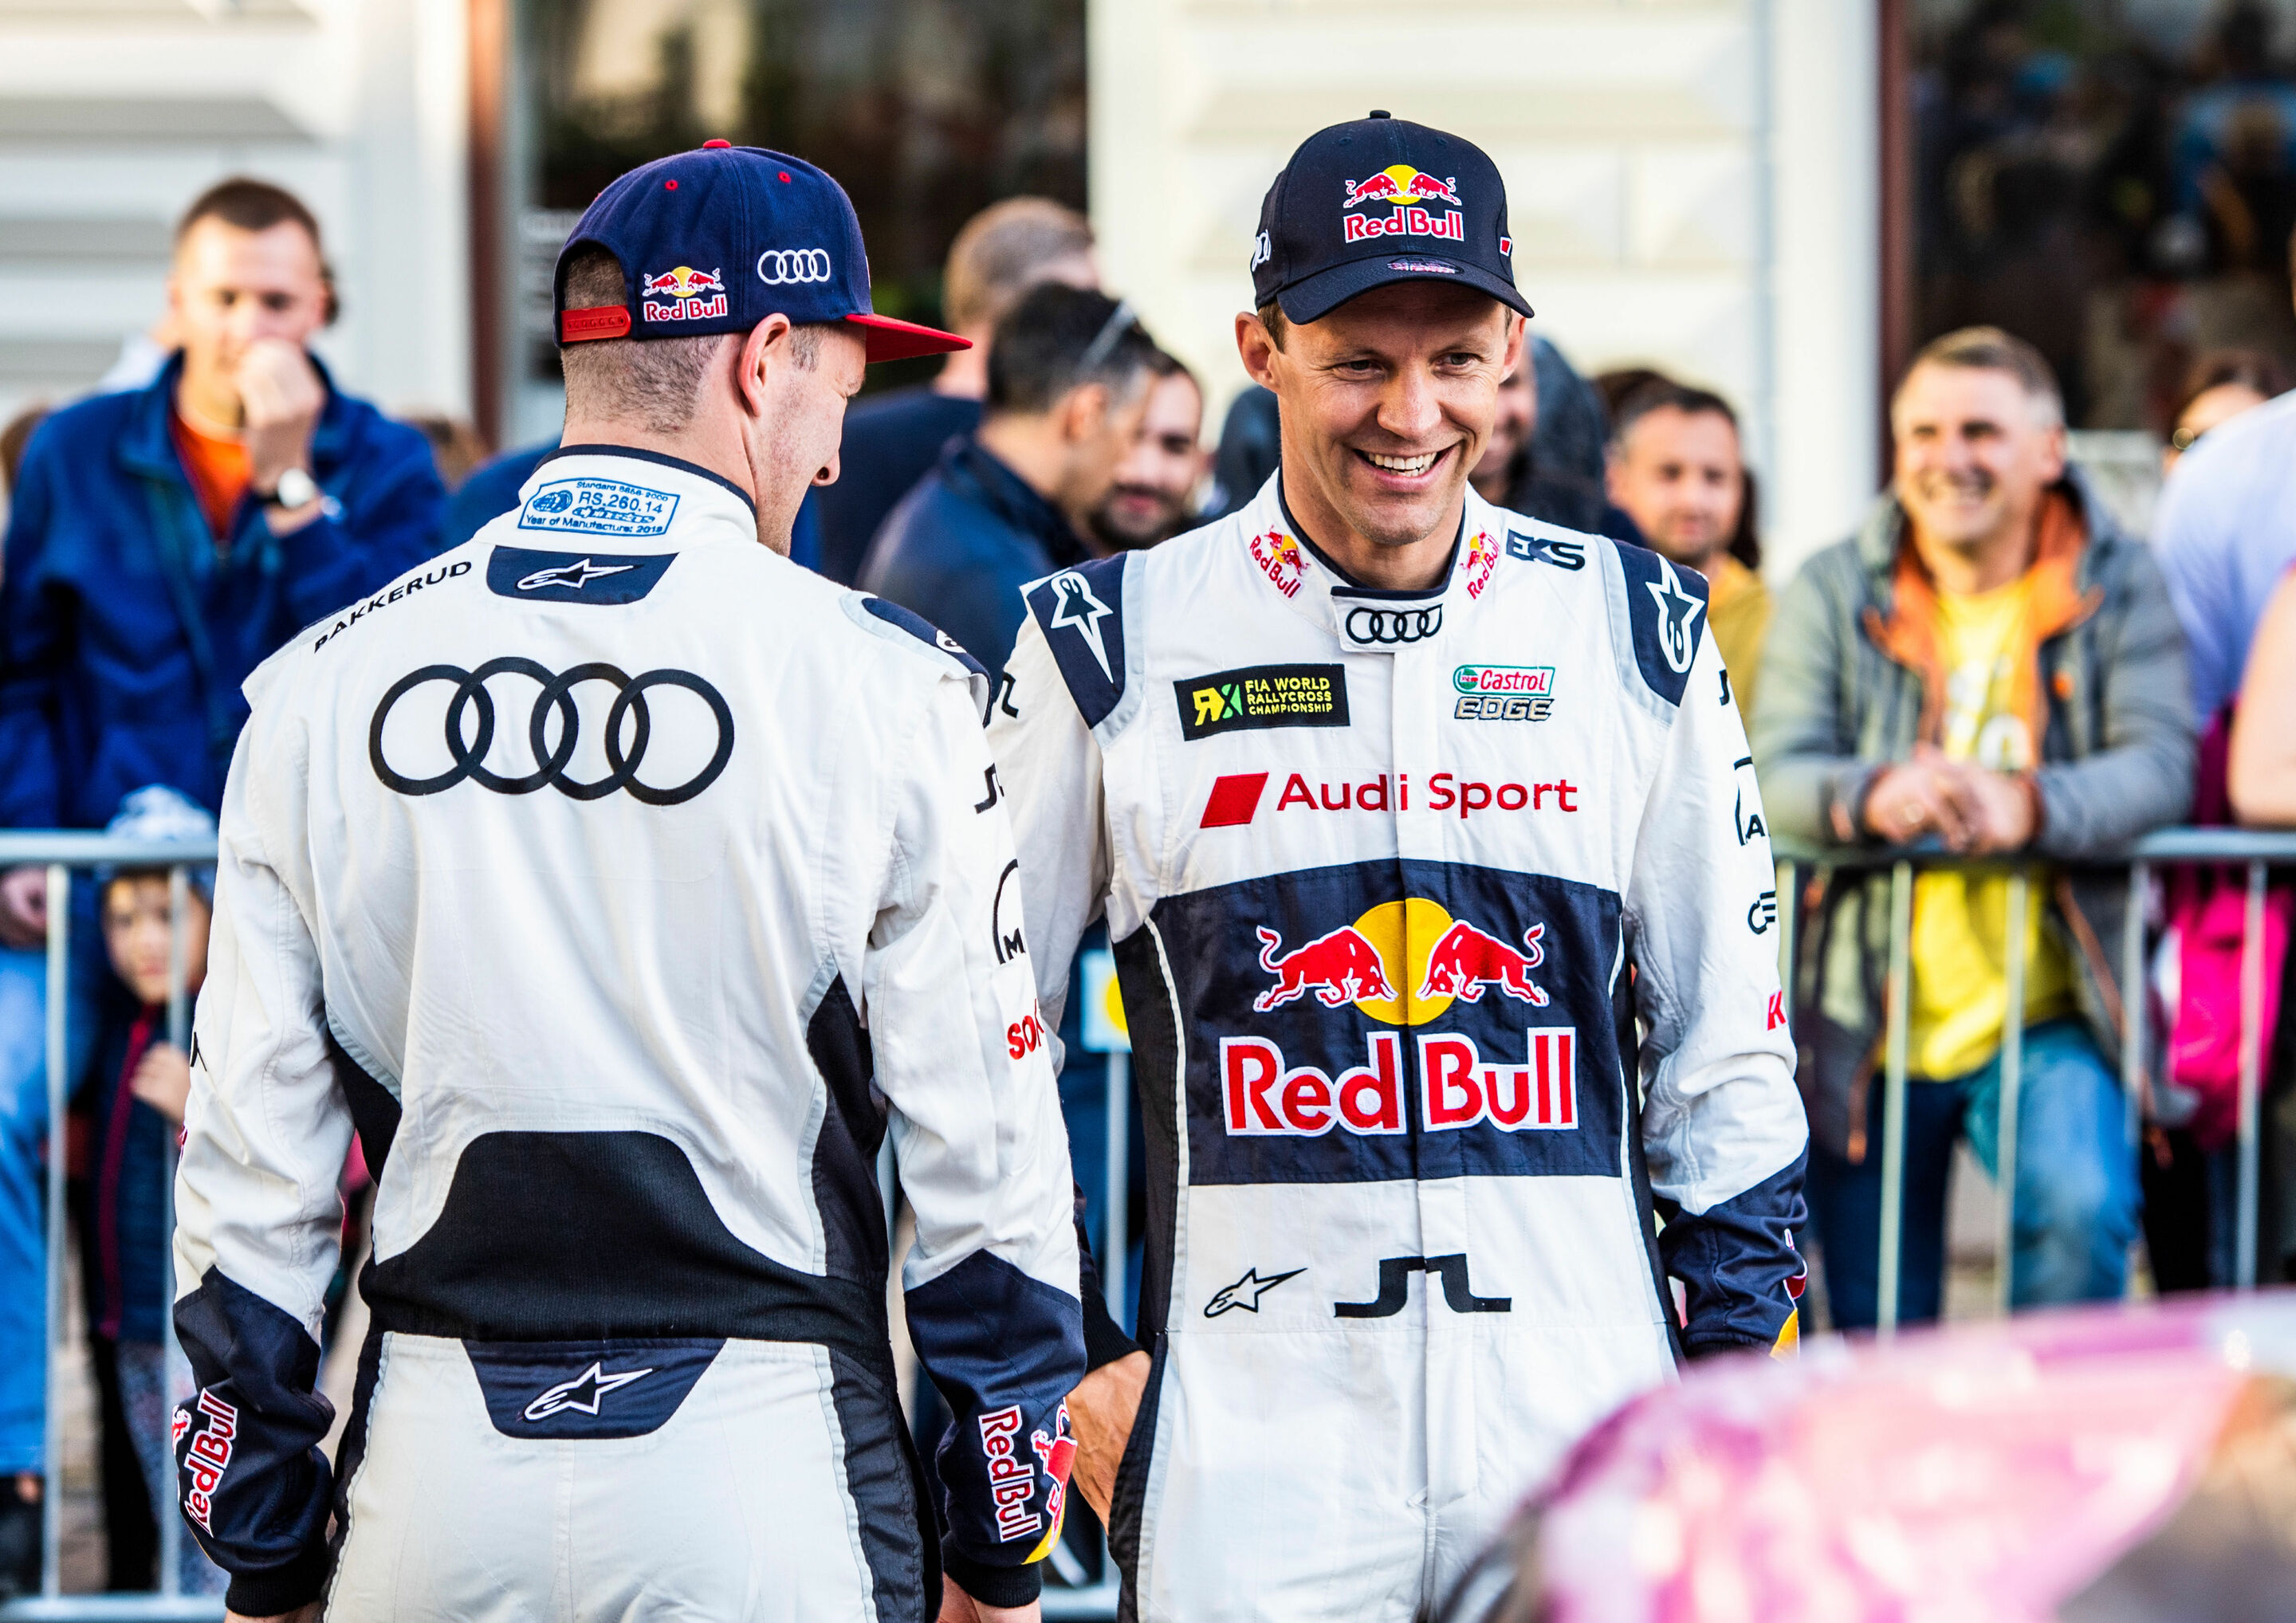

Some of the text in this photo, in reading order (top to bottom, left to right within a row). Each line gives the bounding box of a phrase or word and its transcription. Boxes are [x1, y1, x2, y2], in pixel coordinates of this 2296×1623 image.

[1343, 206, 1464, 242] Red Bull
[644, 294, 728, 322] Red Bull
[576, 481, 616, 491] Standard
[579, 491, 662, 514] RS.260.14
[526, 514, 545, 525] Year
[549, 517, 560, 526] of
[562, 517, 633, 532] Manufacture:
[1506, 529, 1586, 572] EKS
[1249, 536, 1302, 599] Red Bull
[1467, 534, 1500, 599] Red Bull
[1245, 678, 1331, 693] FIA WORLD
[1480, 670, 1546, 691] Castrol
[1247, 690, 1332, 705] RALLYCROSS
[1248, 703, 1333, 715] CHAMPIONSHIP
[1454, 696, 1555, 721] EDGE
[1276, 772, 1578, 819] Audi Sport
[1220, 1027, 1578, 1136] Red Bull
[191, 1387, 238, 1469] Bull
[978, 1405, 1042, 1542] Red Bull
